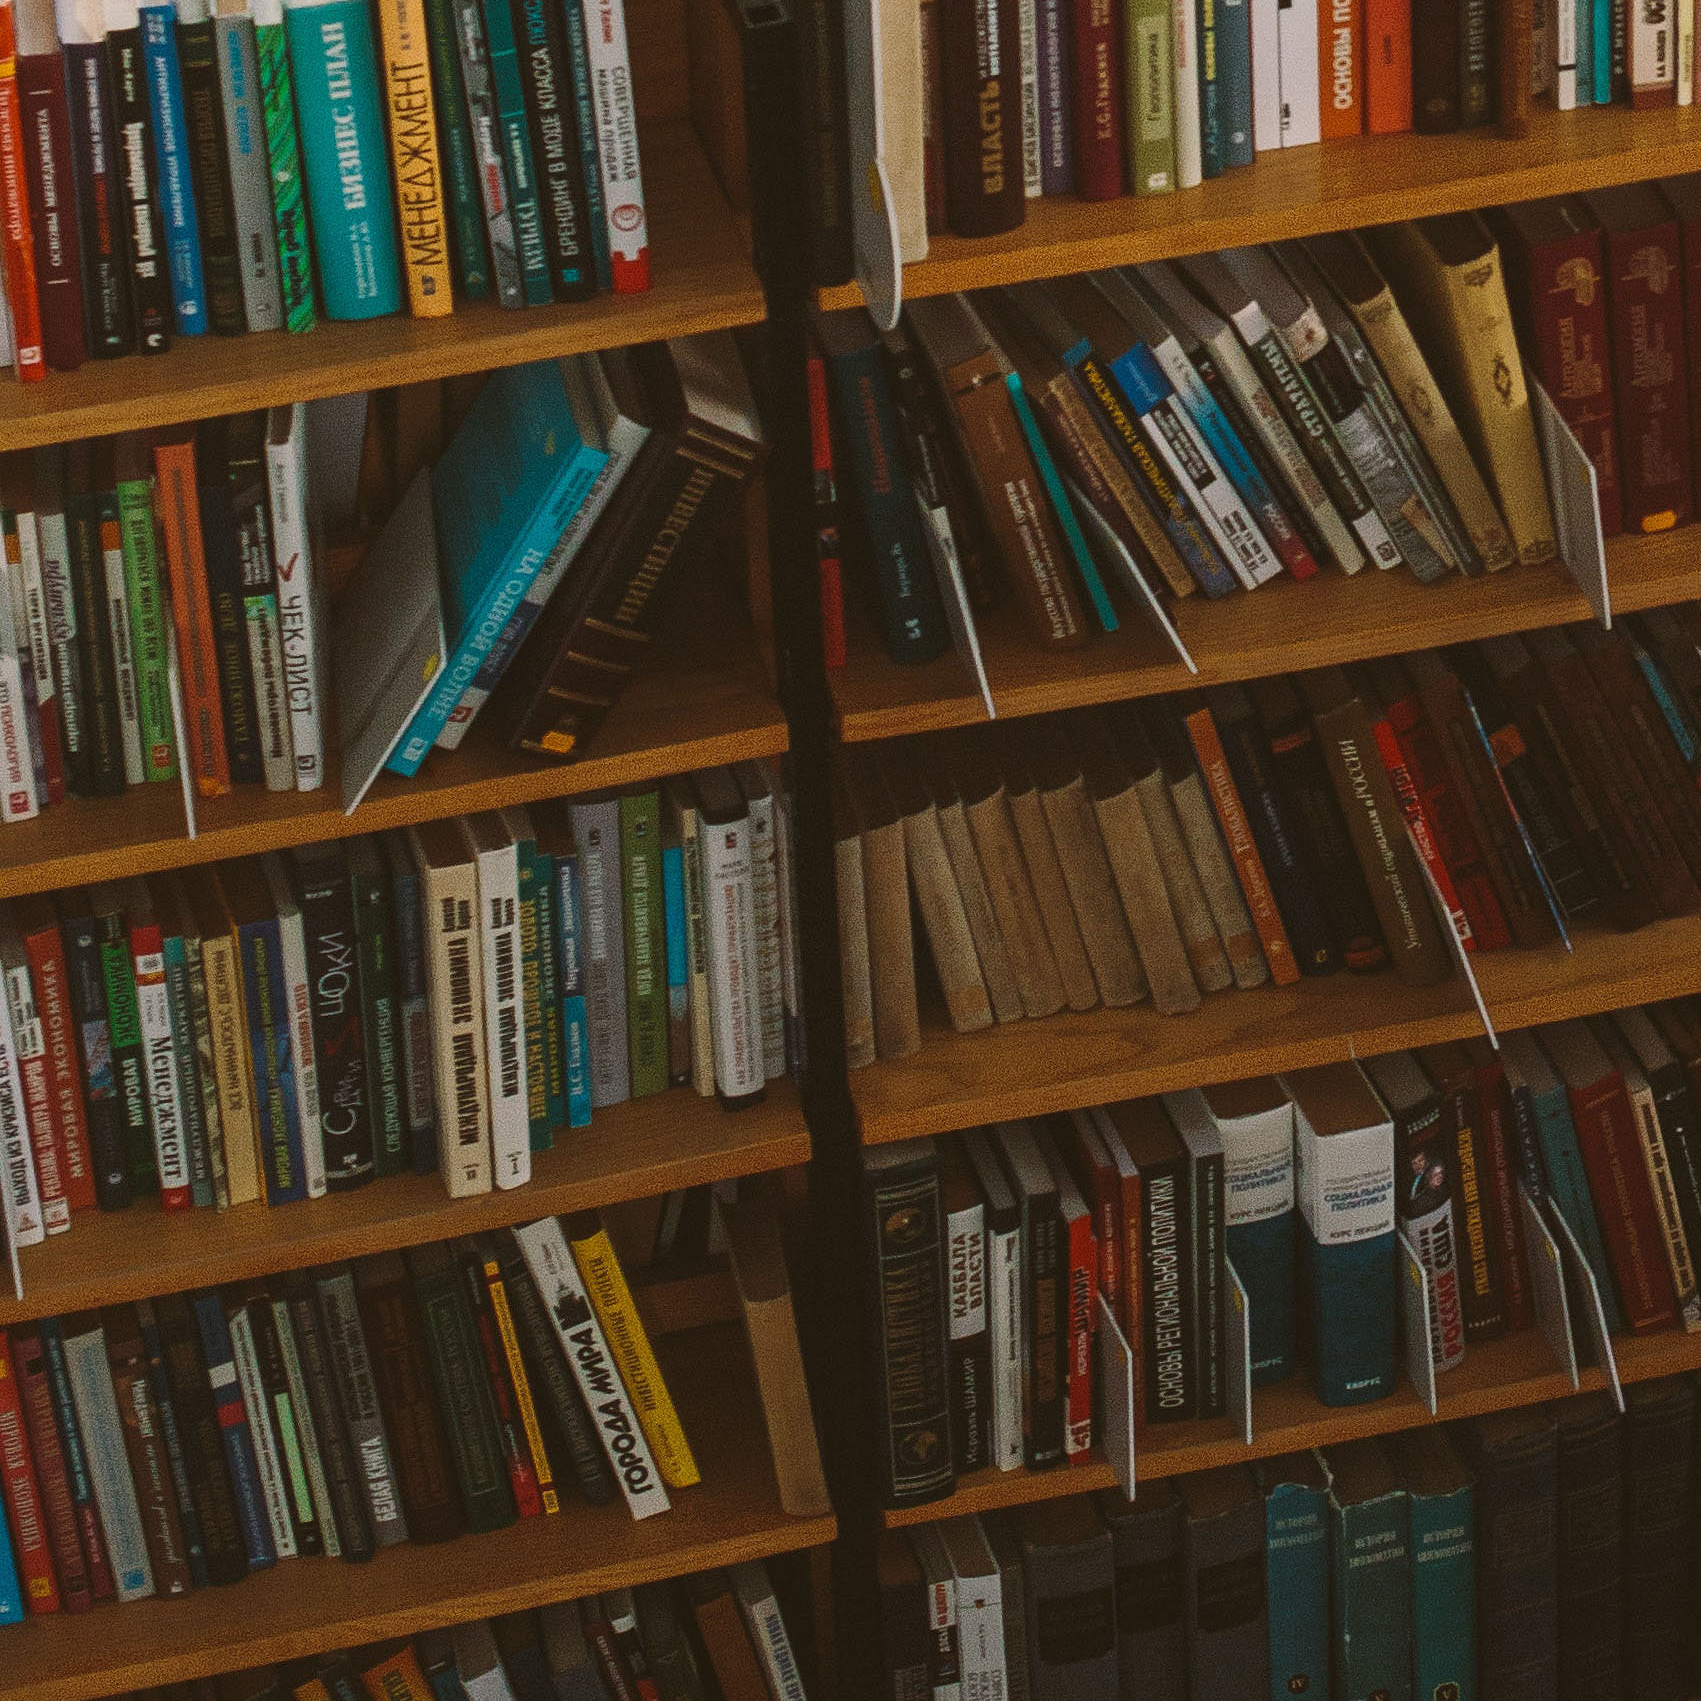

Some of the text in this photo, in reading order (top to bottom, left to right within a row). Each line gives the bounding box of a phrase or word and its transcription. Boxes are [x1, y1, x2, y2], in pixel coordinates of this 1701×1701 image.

[321, 21, 368, 209] БИЗНЕС ПЛАН
[529, 47, 558, 110] КЛАССА
[1333, 27, 1353, 109] ОСНОВЫ
[36, 109, 63, 267] ОСНОВЫ МЕНЕДЖМЕНТА
[391, 61, 444, 267] МЕНЕДЖМЕНТ
[540, 113, 566, 159] МОДЕ
[546, 161, 568, 172] В
[978, 80, 1004, 194] ВЛАСТЬ
[549, 177, 579, 256] БРЕНДИНГ
[612, 462, 719, 622] ИНВЕСТИЦИИ
[280, 595, 314, 716] ЧЕК-ЛИСТ
[427, 547, 544, 718] НА ОДНОЙ ВОЛНЕ
[40, 958, 85, 1178] МИРОВАЯ ЭКОНОМИКА
[446, 936, 481, 1145] МЕЖДУНАРОДНАЯ ЭКОНОМИКА
[949, 1232, 971, 1319] КАББАЛА
[965, 1232, 985, 1312] ВЛАСТИ
[1146, 1175, 1186, 1408] ОСНОВЫ РЕГИОНАЛЬНОЙ ПОЛИТИКИ
[1428, 1214, 1464, 1357] РОССИЯ США
[567, 1328, 655, 1496] ГОРОДА МИРА
[362, 1437, 399, 1522] БЕЛАЯ КНИГА
